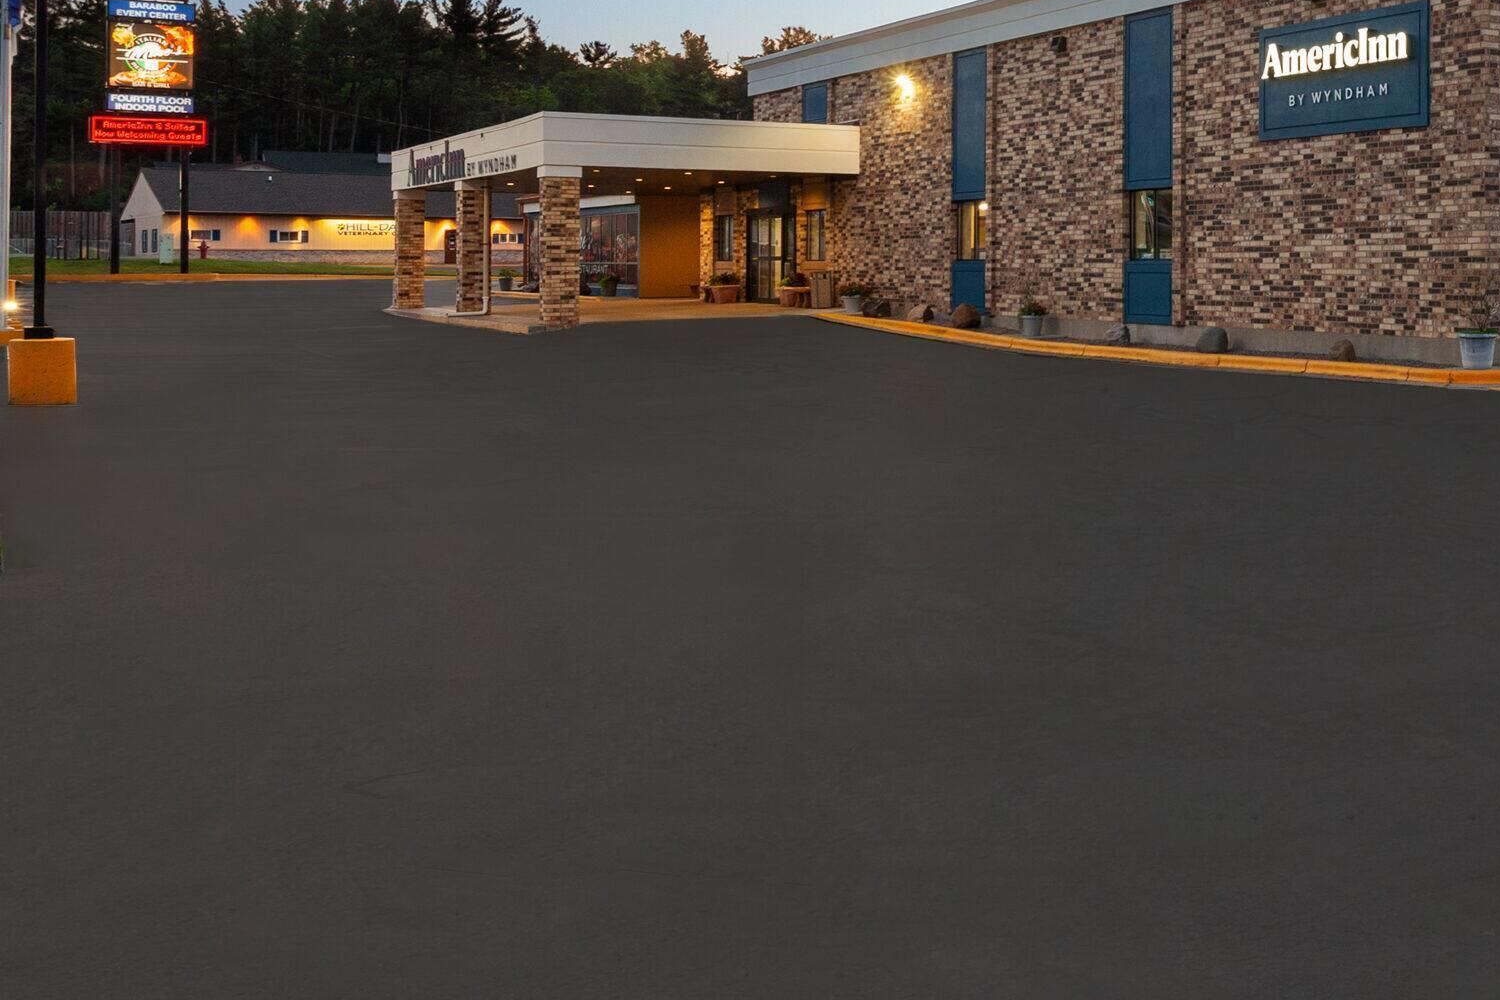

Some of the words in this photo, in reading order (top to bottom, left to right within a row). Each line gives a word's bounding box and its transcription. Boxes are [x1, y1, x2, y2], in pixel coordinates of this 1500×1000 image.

[129, 1, 176, 12] BARABOO
[116, 8, 148, 18] EVENT
[149, 11, 187, 21] CENTER
[1261, 27, 1408, 80] AmericInn
[110, 93, 154, 103] FOURTH
[156, 96, 192, 105] FLOOR
[1288, 94, 1305, 107] BY
[1311, 82, 1388, 104] WYNDHAM
[115, 102, 156, 112] INDOOR
[158, 104, 188, 113] POOL
[165, 123, 196, 131] Suites
[94, 129, 114, 138] Now
[117, 130, 165, 141] Welcoming
[168, 132, 202, 140] Guests
[407, 139, 466, 187] AmericInn
[478, 154, 518, 175] WYNDHAM
